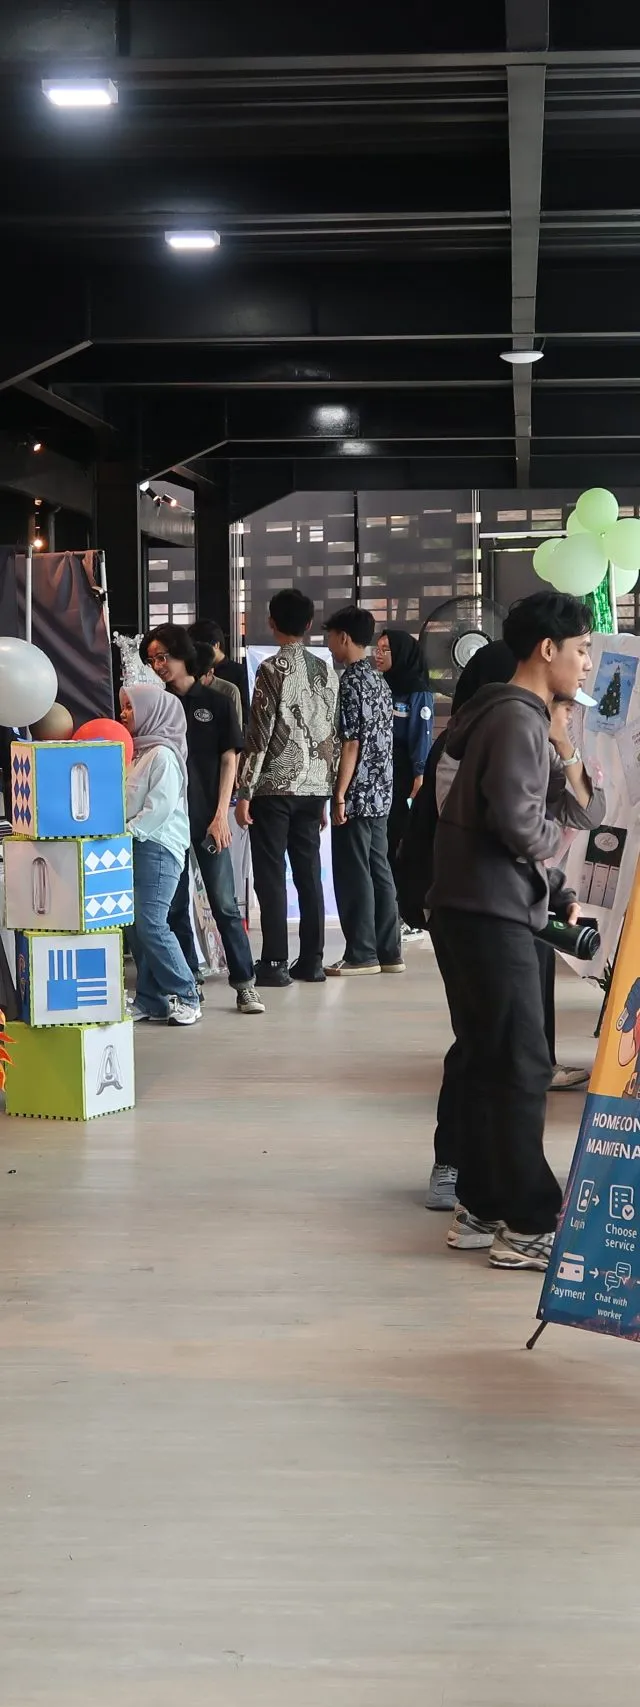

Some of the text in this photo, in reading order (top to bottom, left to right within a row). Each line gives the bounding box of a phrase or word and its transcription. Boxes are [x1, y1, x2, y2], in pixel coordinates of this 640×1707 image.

[96, 1044, 123, 1096] A
[570, 1217, 585, 1231] Login
[605, 1223, 638, 1239] Choose
[605, 1238, 636, 1252] service
[550, 1284, 586, 1301] Payment
[594, 1292, 628, 1308] Chat with
[597, 1308, 623, 1320] worker
